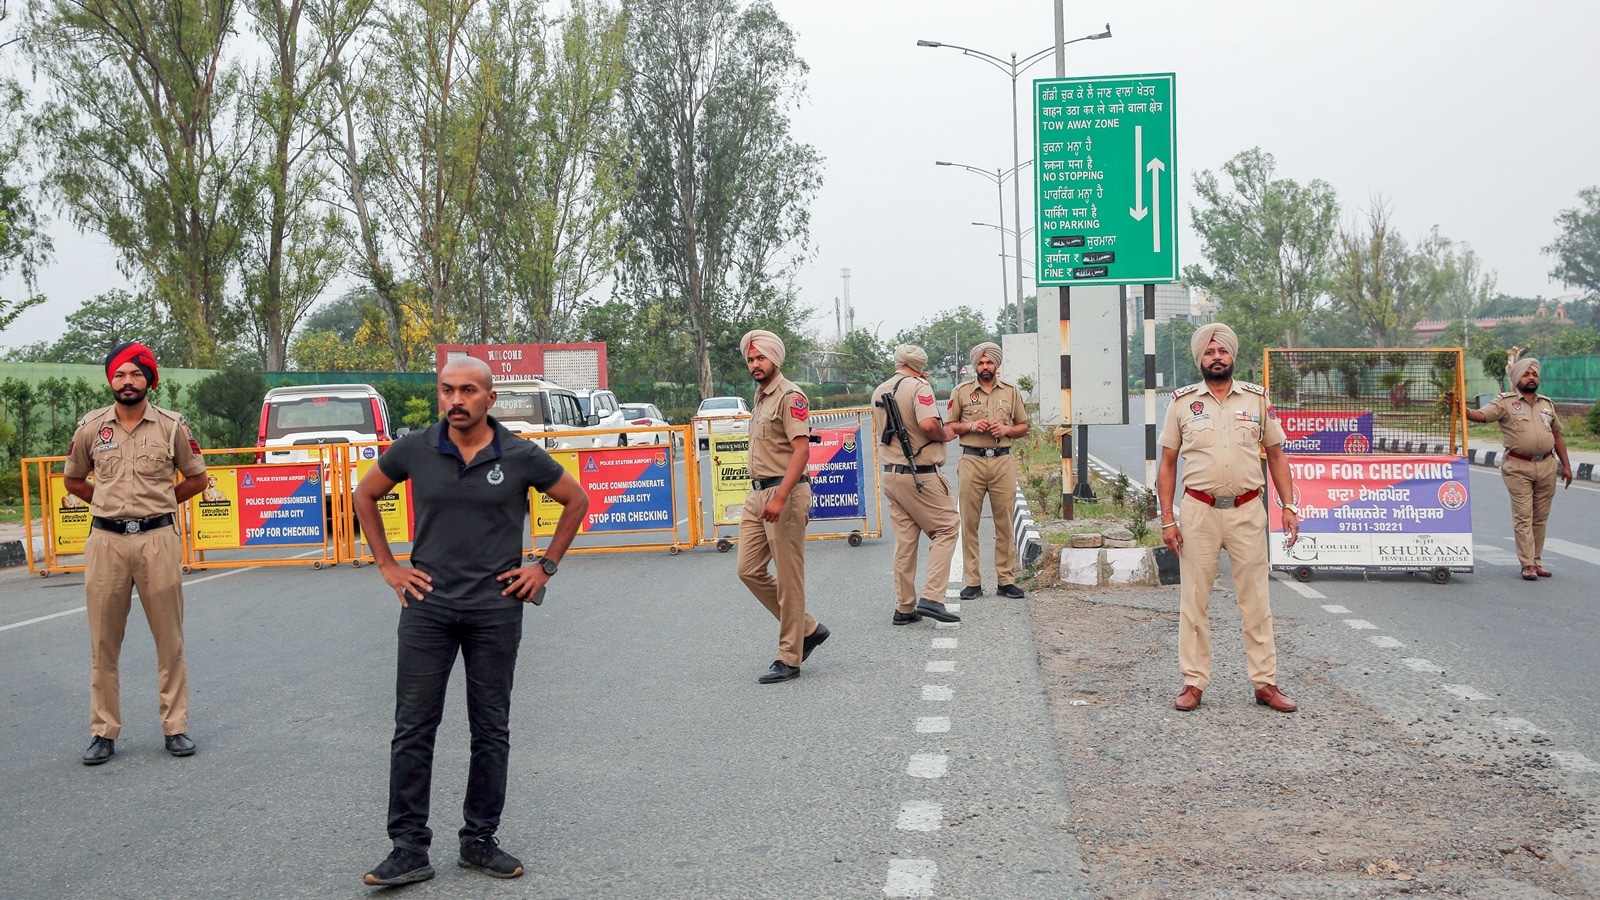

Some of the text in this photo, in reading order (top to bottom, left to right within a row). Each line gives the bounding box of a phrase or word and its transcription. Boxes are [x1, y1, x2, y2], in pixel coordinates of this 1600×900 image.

[1077, 85, 1084, 99] ਕੇ
[1087, 84, 1094, 99] ਲੈ
[1097, 88, 1112, 98] ਜਾਣ
[1115, 86, 1134, 97] ਵਾਲਾ
[1136, 82, 1156, 96] ਖੇਤਰ
[1042, 98, 1163, 118] वाहन उठा कर ले जाने वाला क्षेत्र
[1042, 118, 1119, 130] TOW AWAY ZONE
[1085, 136, 1092, 151] ਹੈ
[1043, 154, 1093, 170] रुकना मना है
[1043, 170, 1104, 181] NO STOPPING
[1044, 186, 1074, 200] ਪਾਰਕਿੰਗ
[1096, 184, 1103, 198] ਹੈ
[1044, 203, 1097, 219] पार्किंग मना है
[1044, 220, 1100, 230] NO PARKING
[1087, 236, 1116, 249] ਜੁਰਮਾਨਾ
[1044, 268, 1064, 277] FINE
[488, 350, 523, 361] WELCOME
[501, 362, 512, 372] TO
[1287, 418, 1358, 432] CHECKING
[1288, 463, 1453, 480] STOP FOR CHECKING
[588, 479, 664, 490] POLICE COMMISSIONERATE
[810, 475, 844, 484] TSAR CITY
[245, 496, 317, 506] POLICE COMMISSIONERATE
[604, 494, 651, 504] AMRITSAR CITY
[820, 493, 859, 507] CHECKING
[260, 510, 304, 519] AMRITSAR CITY
[589, 510, 668, 524] STOP FOR CHECKING
[1296, 504, 1328, 521] ਪੁਲਿਸ
[246, 526, 320, 538] STOP FOR CHECKING
[1339, 522, 1403, 531] 97811-30221
[1378, 546, 1471, 555] KHURANA
